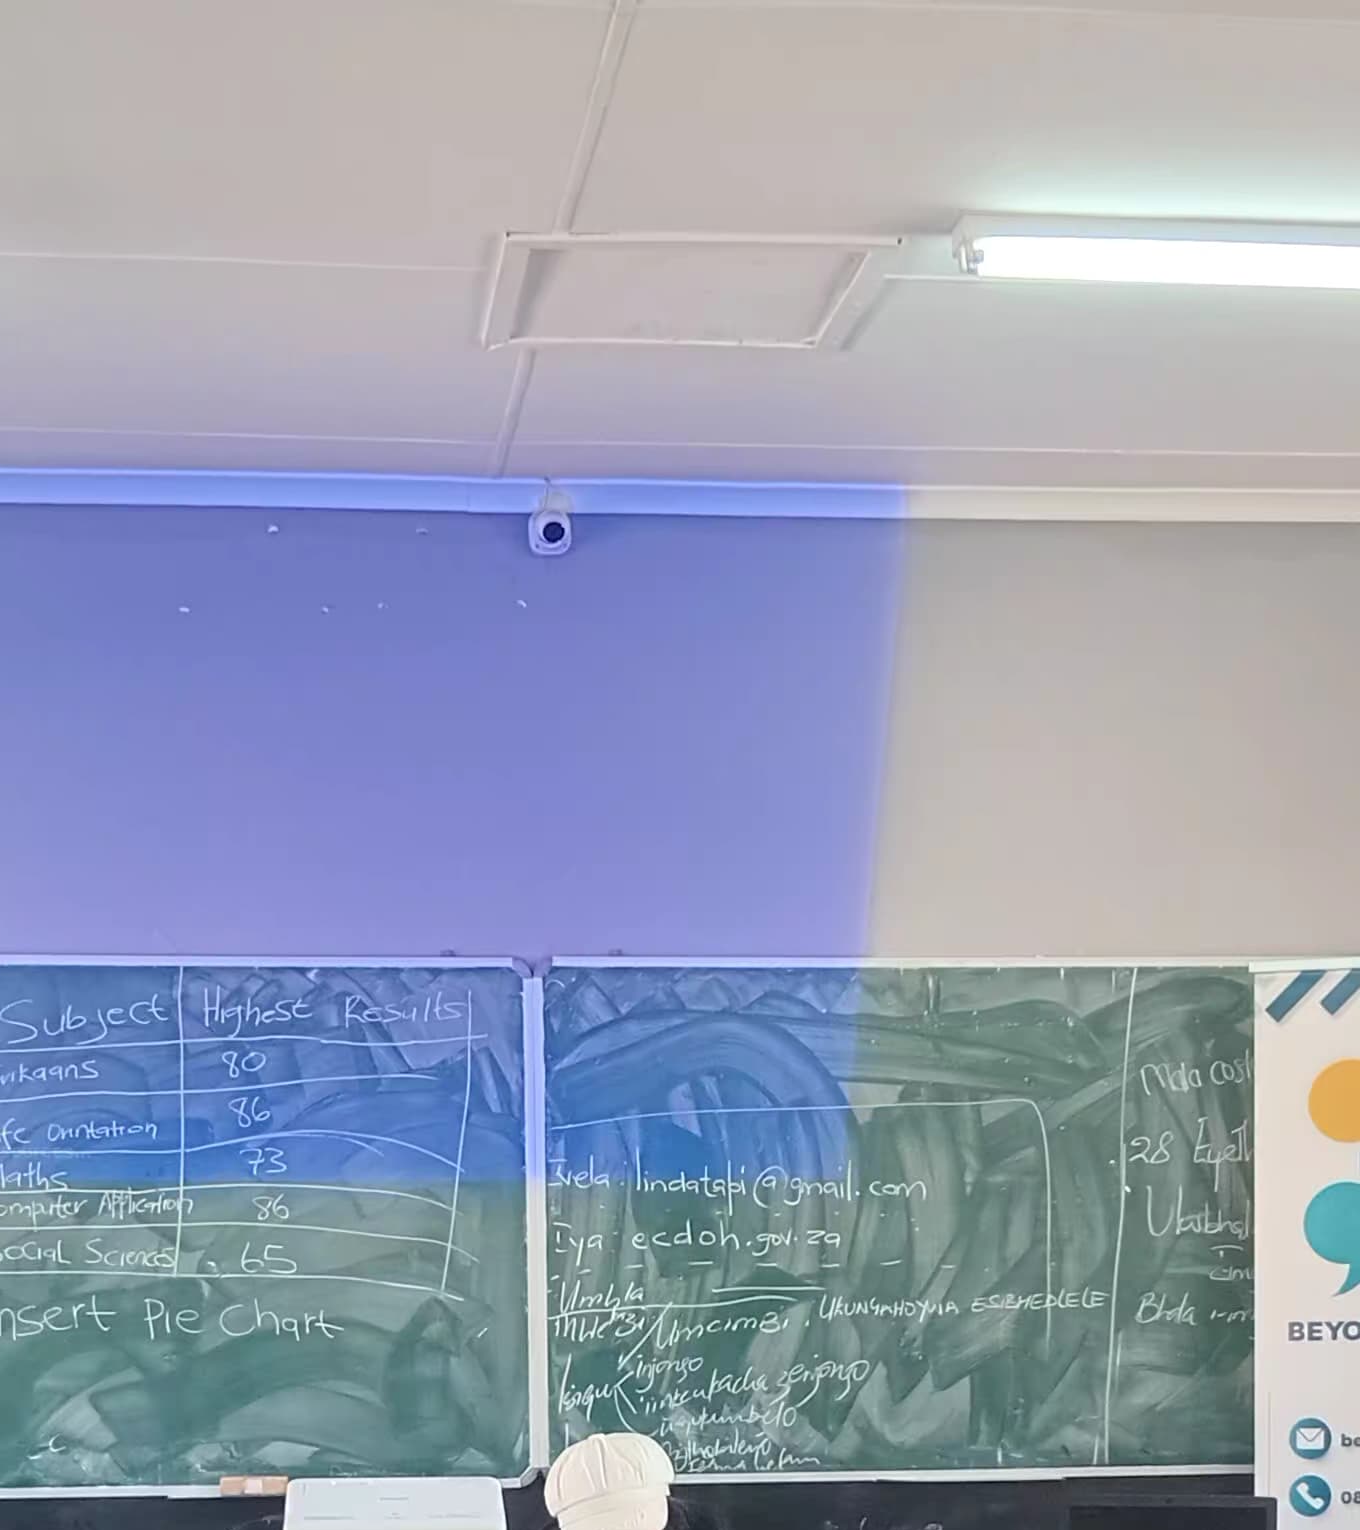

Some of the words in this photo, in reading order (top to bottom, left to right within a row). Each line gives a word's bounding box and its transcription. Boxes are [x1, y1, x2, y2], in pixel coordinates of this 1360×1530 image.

[203, 987, 313, 1039] Highest
[343, 996, 466, 1026] Results
[221, 1051, 266, 1078] 80
[228, 1096, 272, 1128] 86
[245, 1149, 288, 1174] 73
[1129, 1130, 1174, 1164] 28
[251, 1194, 290, 1222] 86
[240, 1241, 297, 1274] 65
[144, 1298, 208, 1340] Pie
[219, 1299, 344, 1341] Chart
